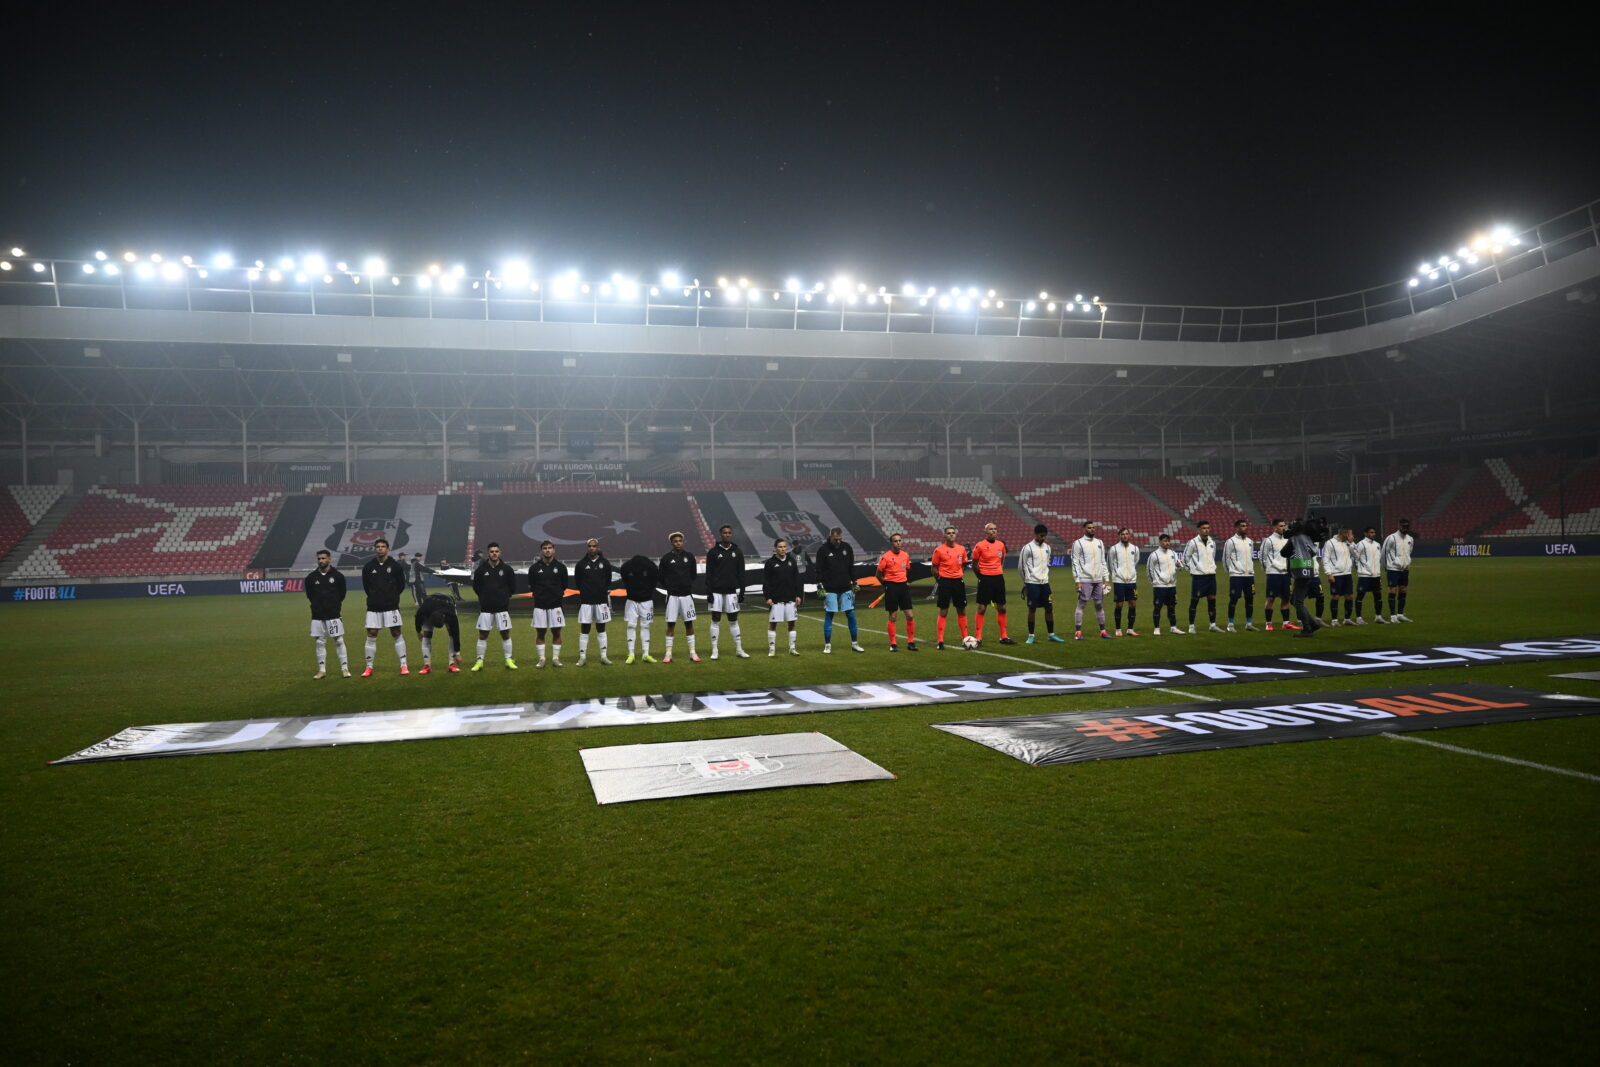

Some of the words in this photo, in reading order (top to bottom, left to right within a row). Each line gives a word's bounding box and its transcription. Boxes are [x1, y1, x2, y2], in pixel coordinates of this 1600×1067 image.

[543, 463, 563, 471] UEFA
[564, 463, 593, 471] EUROPA
[595, 463, 623, 471] LEAGUE
[1449, 544, 1492, 556] #FOOTBALL
[1545, 544, 1577, 554] UEFA
[1052, 556, 1065, 566] ALL
[147, 584, 186, 595] UEFA
[240, 580, 284, 593] WELCOME
[285, 580, 304, 591] ALL
[13, 586, 76, 600] #FOOTBALL
[686, 610, 696, 619] 83
[503, 619, 508, 627] 7
[329, 625, 338, 635] 27
[152, 698, 655, 750] UEFA
[695, 662, 1309, 711] EUROPA
[1279, 638, 1600, 670] LEAG
[1075, 692, 1531, 742] #FOOTBALL
